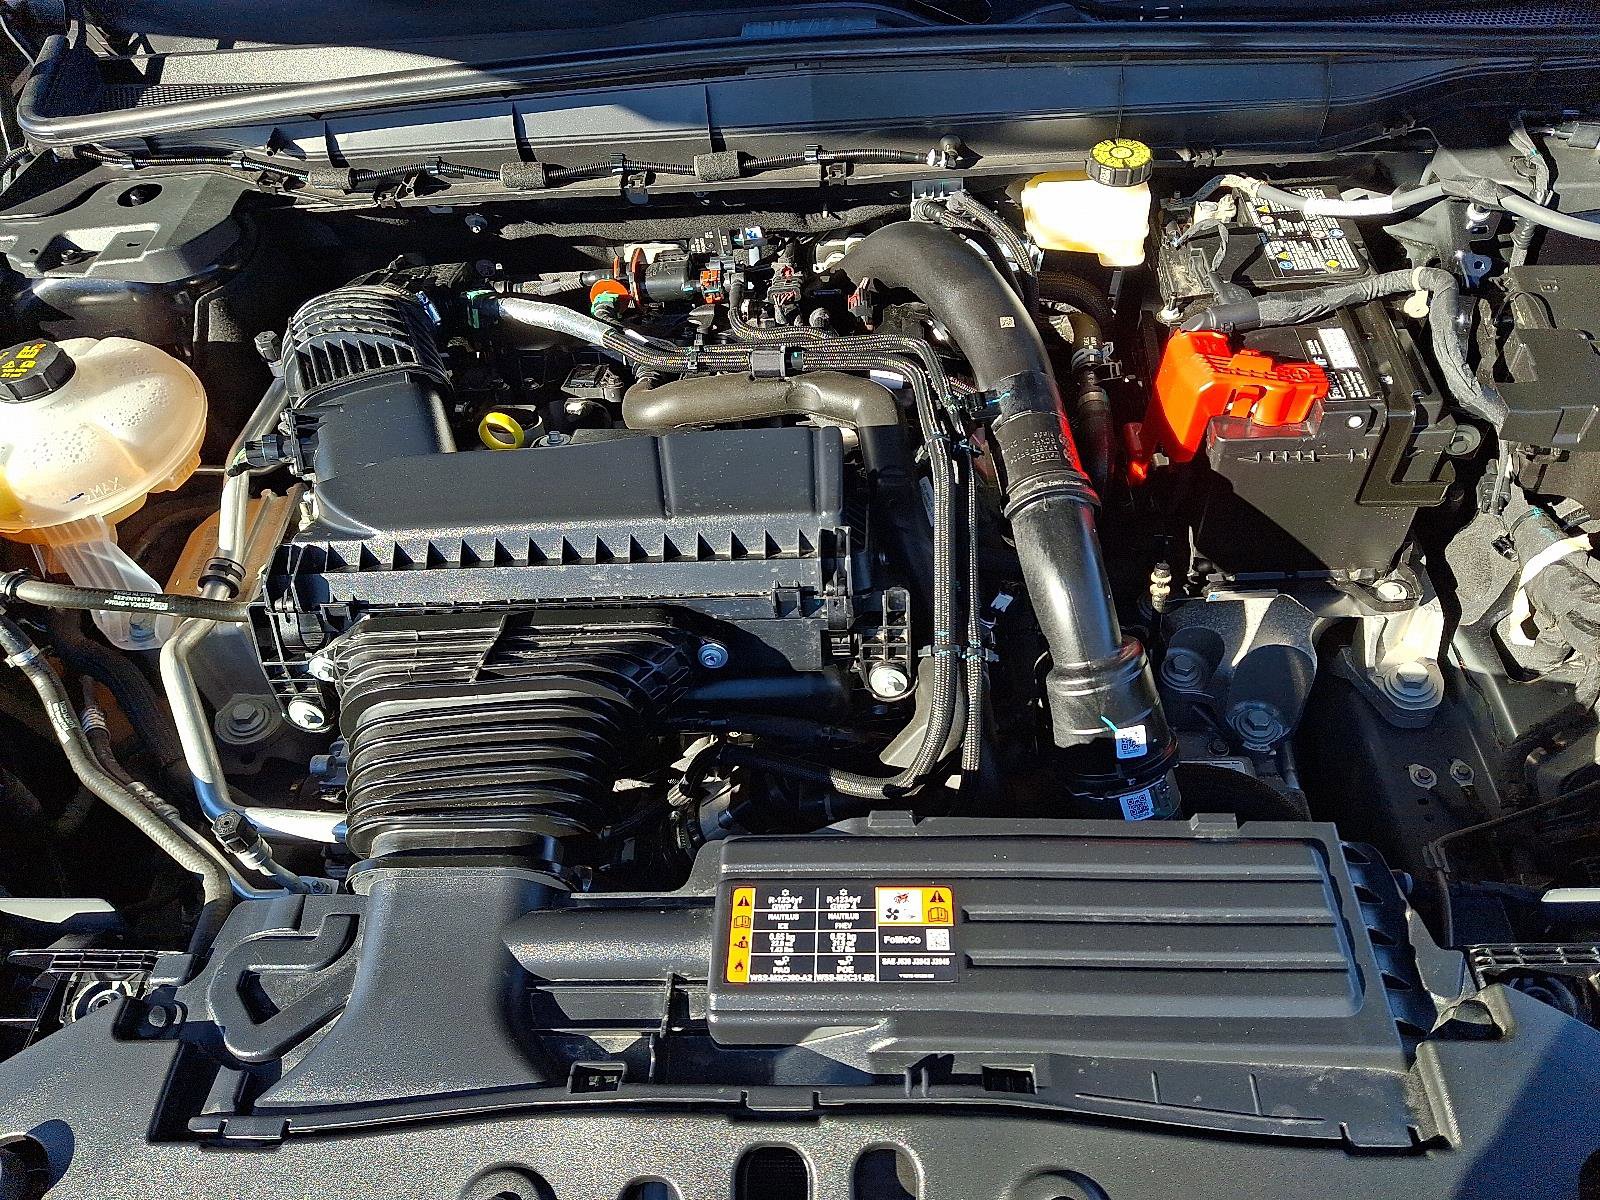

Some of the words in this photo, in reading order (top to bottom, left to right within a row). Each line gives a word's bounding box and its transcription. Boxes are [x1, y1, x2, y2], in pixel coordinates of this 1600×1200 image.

[768, 896, 803, 904] R-1234yf
[827, 896, 861, 904] R-1234yf
[786, 933, 795, 942] kg
[847, 933, 856, 942] kg
[883, 935, 922, 944] FoMoCo
[837, 966, 854, 974] POE
